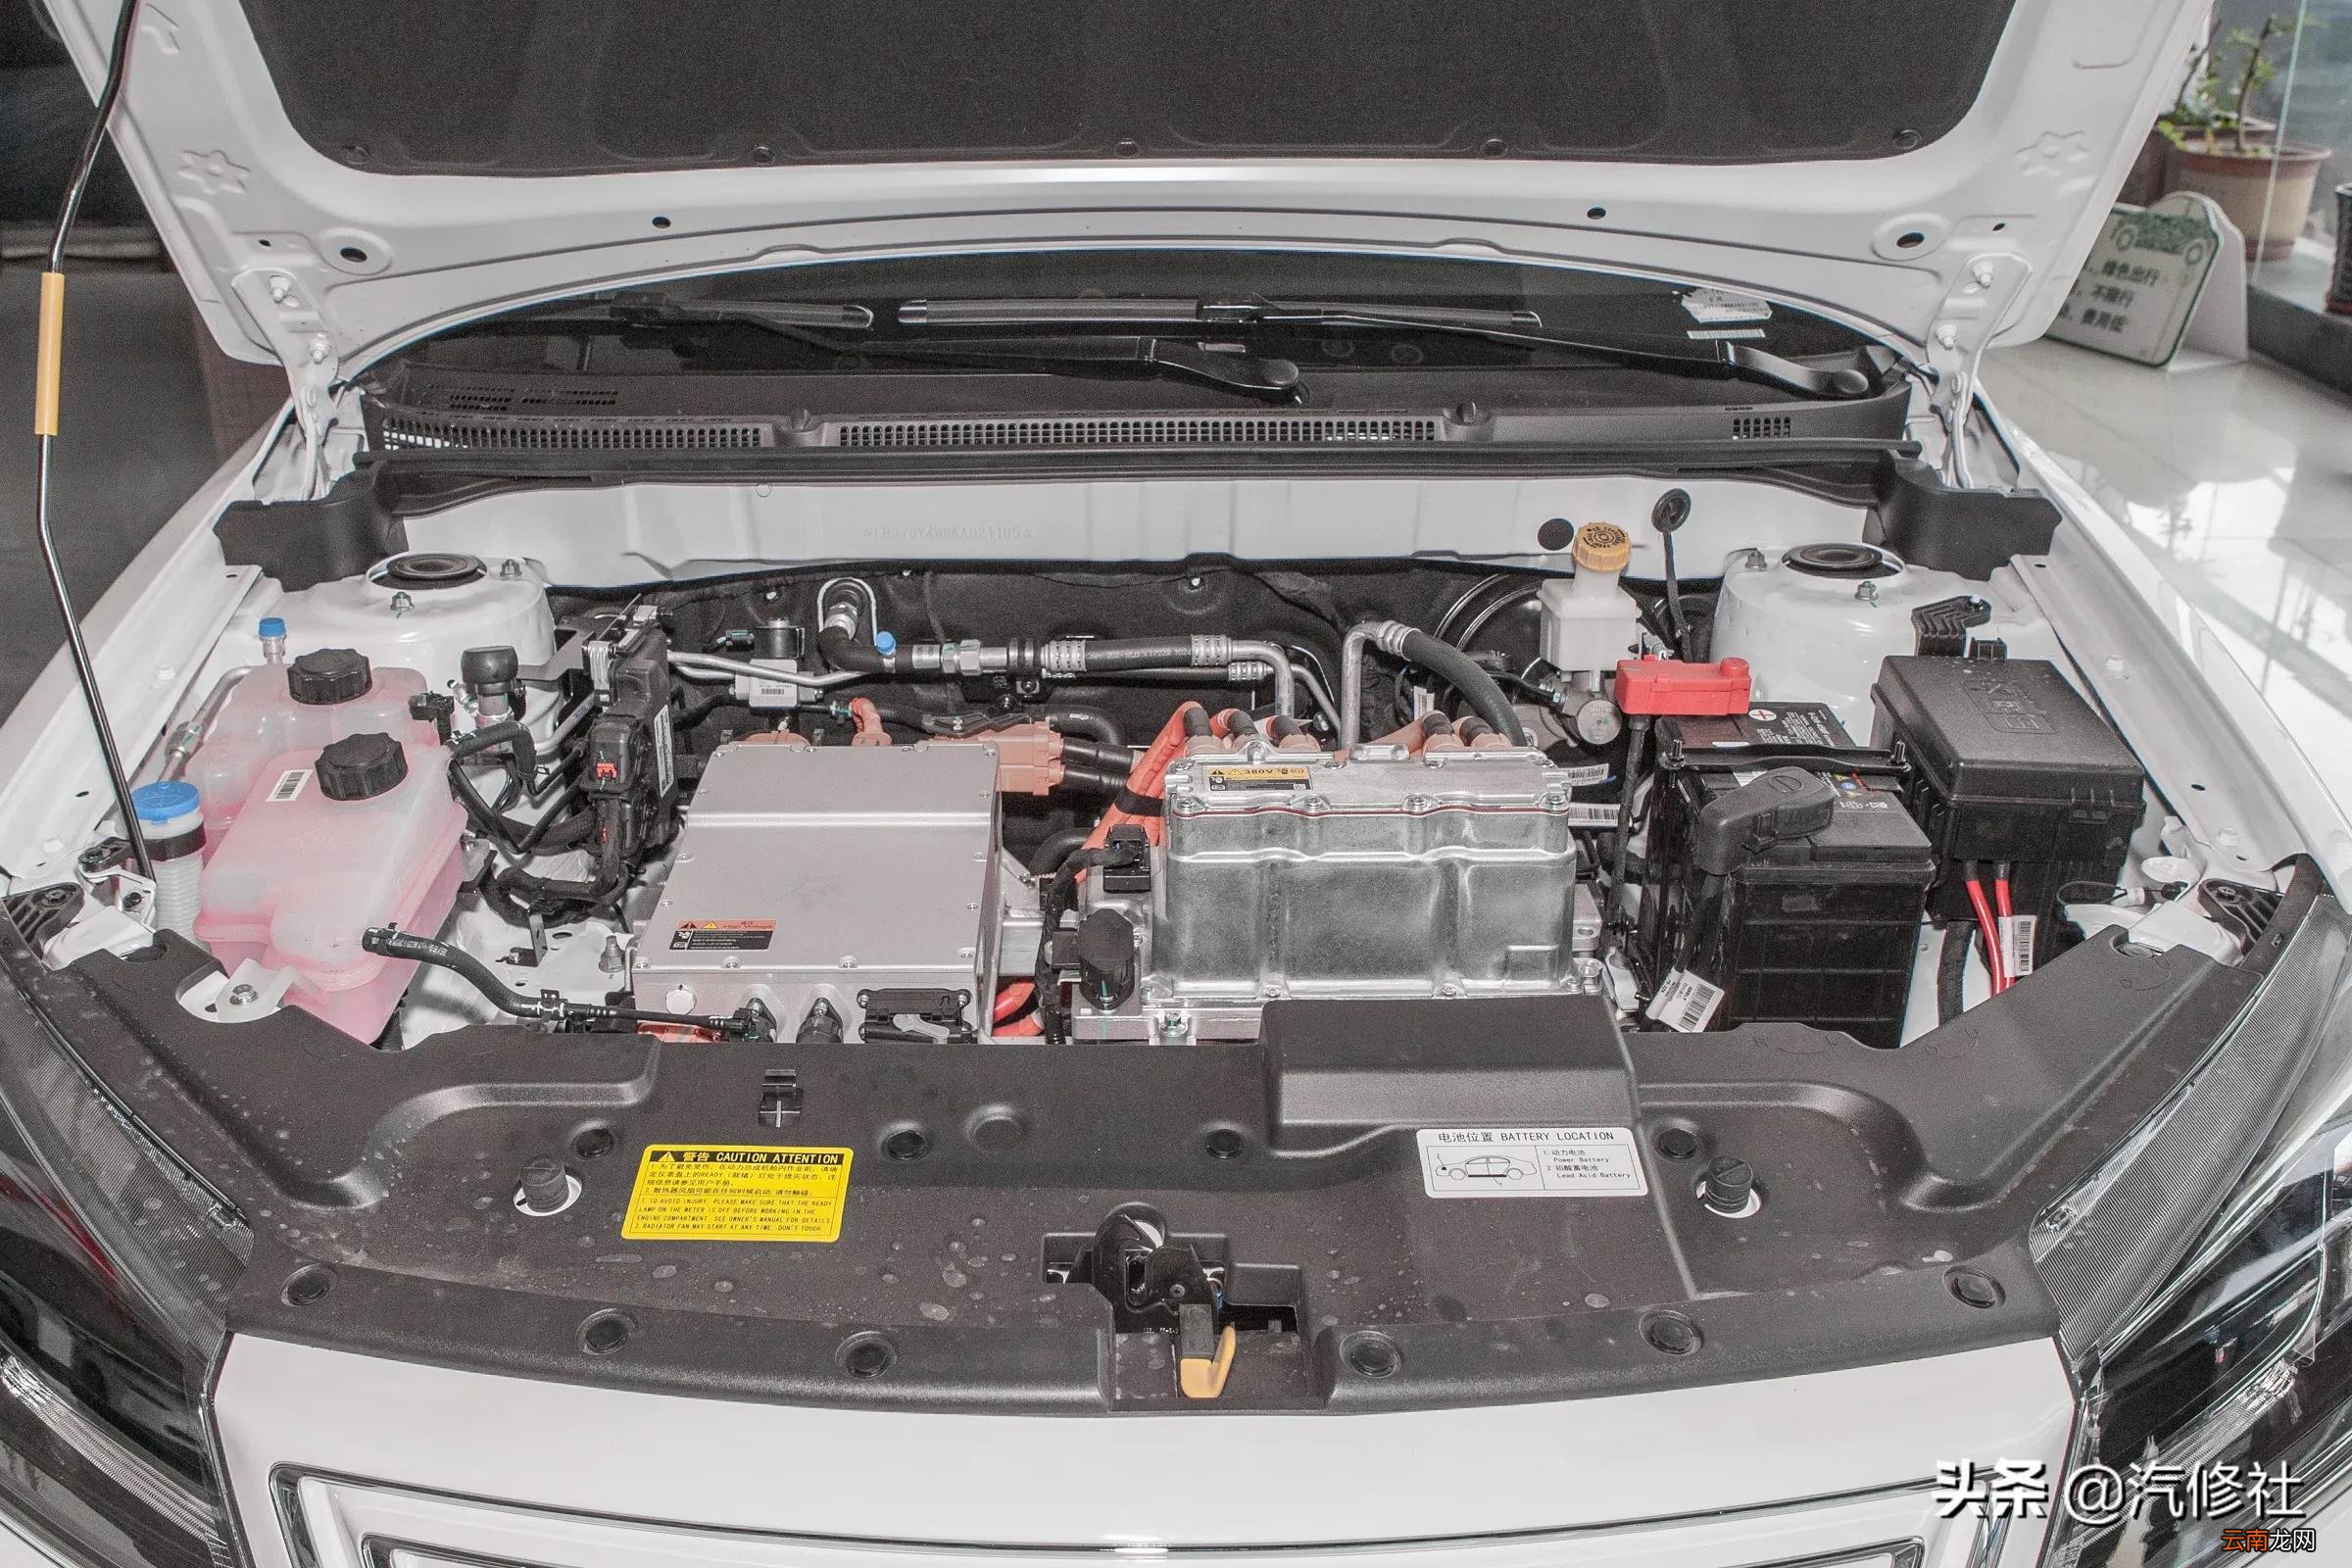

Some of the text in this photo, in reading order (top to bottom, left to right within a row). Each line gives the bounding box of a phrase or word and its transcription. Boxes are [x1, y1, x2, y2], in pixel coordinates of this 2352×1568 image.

[1438, 1131, 1614, 1143] 电池位置 BATTERY LOCATION
[683, 1152, 839, 1164] 警告 CAUTION ATTENTION
